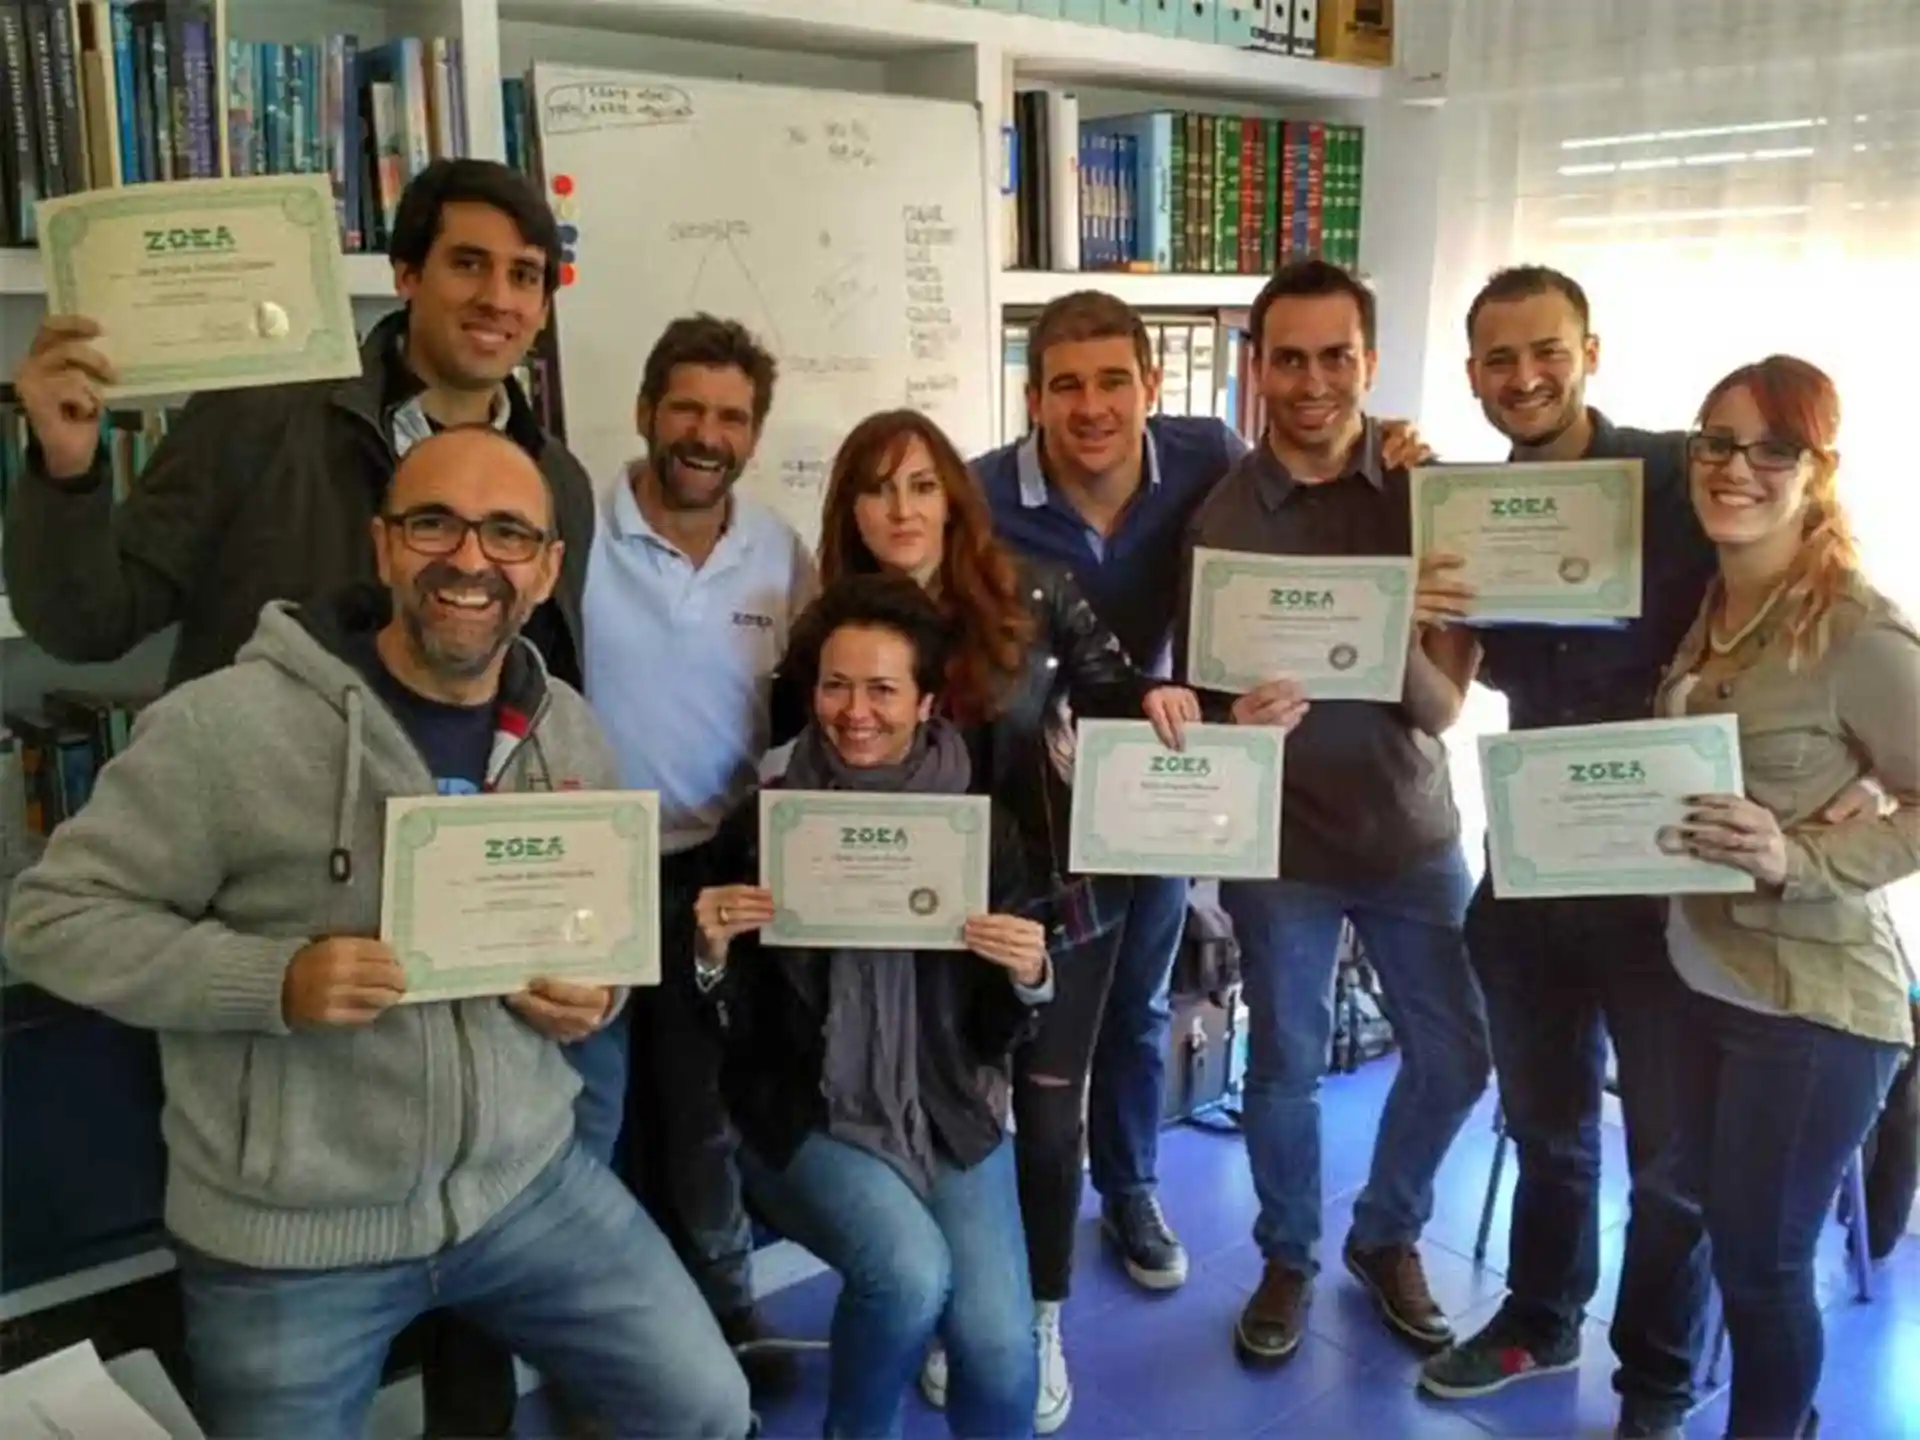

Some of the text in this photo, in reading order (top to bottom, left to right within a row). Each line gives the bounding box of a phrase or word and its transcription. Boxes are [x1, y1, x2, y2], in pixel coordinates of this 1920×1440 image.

[143, 226, 236, 250] ZOEA
[1491, 497, 1558, 514] ZOEA
[1269, 588, 1336, 607] ZOEA
[1150, 755, 1211, 775] ZOEA
[1569, 760, 1647, 781] ZOEA
[485, 836, 566, 858] ZOEA
[841, 826, 908, 849] ZOEA
